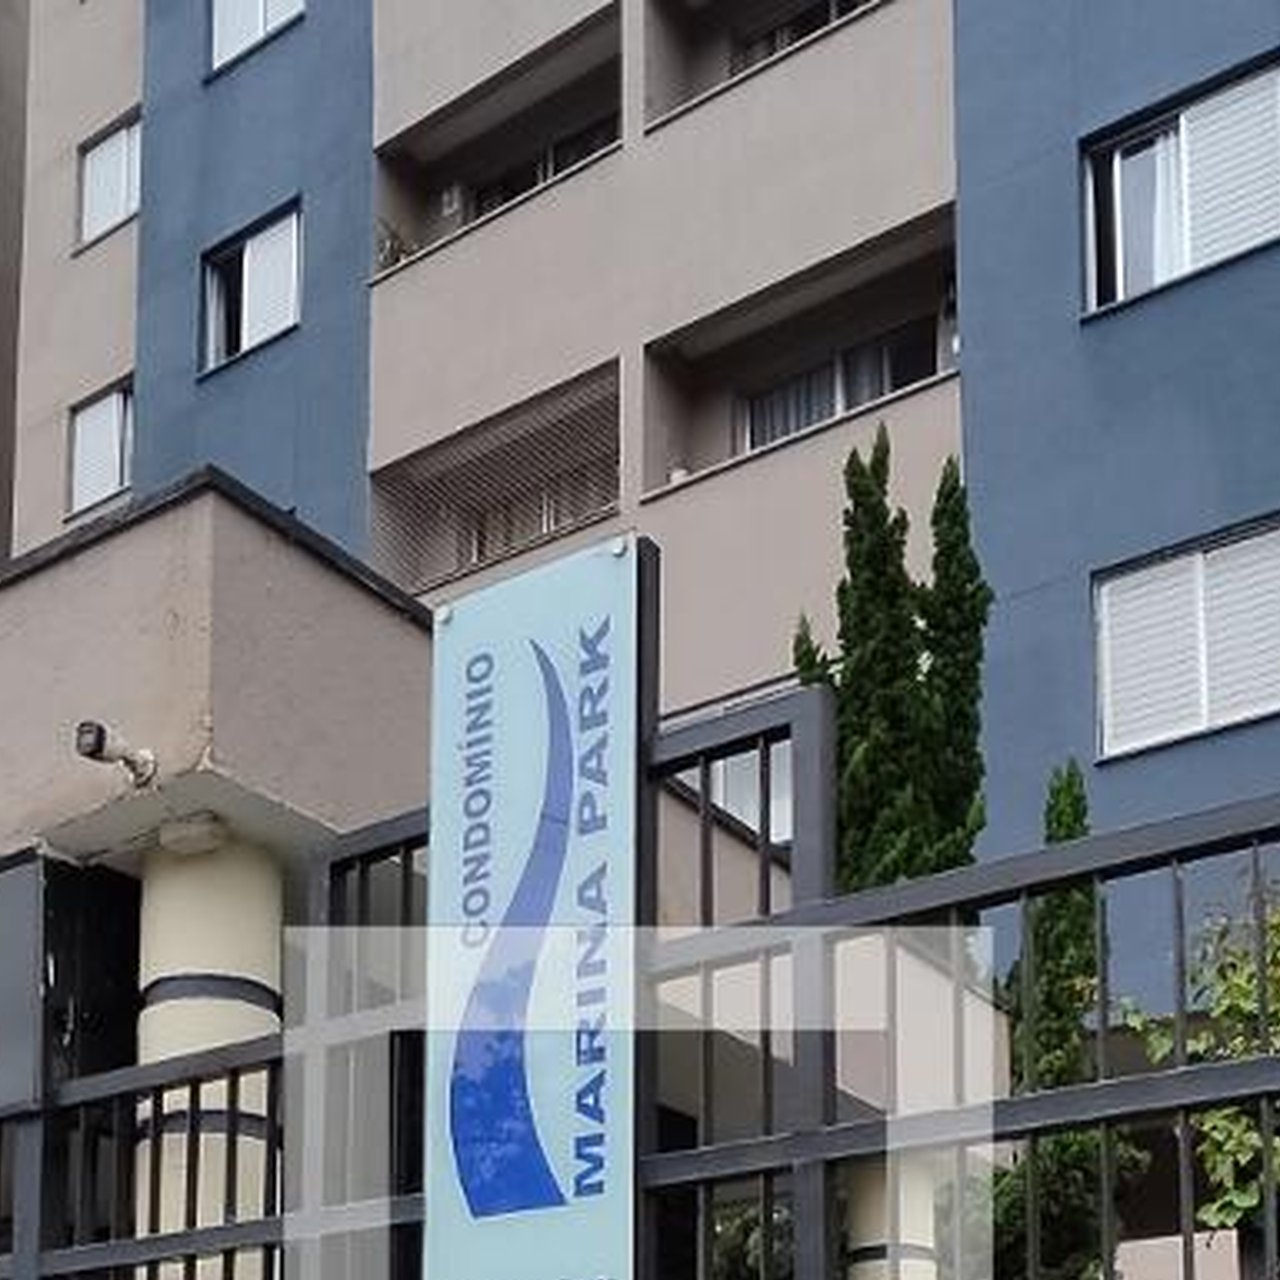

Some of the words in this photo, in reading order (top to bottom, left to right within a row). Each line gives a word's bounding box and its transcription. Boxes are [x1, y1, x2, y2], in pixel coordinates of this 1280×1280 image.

[458, 651, 495, 948] CONDOMÍNIO
[577, 613, 611, 837] PARK
[574, 860, 608, 1199] MARINA
